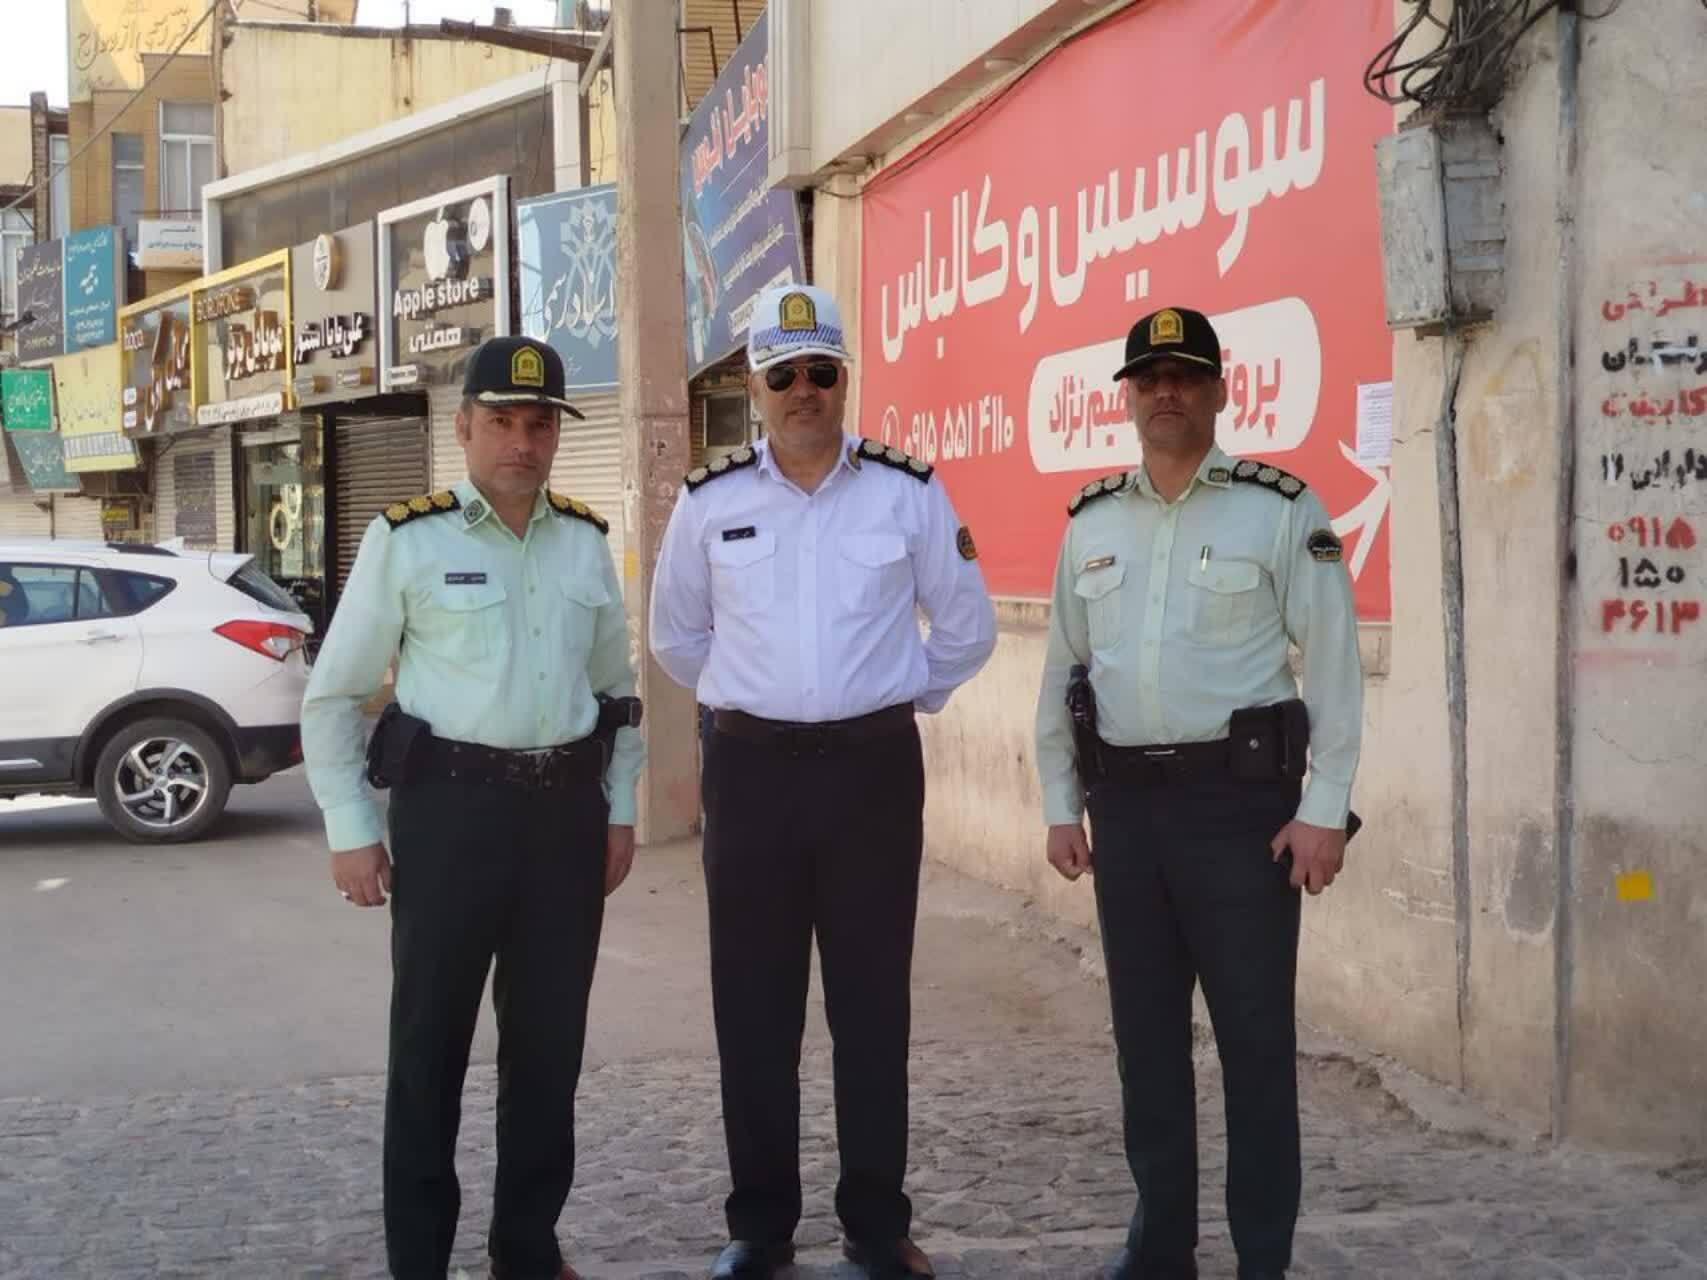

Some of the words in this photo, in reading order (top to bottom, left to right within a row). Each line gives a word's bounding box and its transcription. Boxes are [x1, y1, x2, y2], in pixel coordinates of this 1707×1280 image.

[1049, 78, 1325, 307] سوسیس
[393, 283, 436, 321] Apple
[437, 277, 480, 306] store
[881, 174, 1009, 363] کالباس
[1016, 205, 1040, 335] و
[246, 309, 284, 373] موبایل
[343, 312, 363, 355] علی
[942, 402, 973, 461] ۵۵۱
[978, 394, 1014, 457] ۴۱۱۰
[1607, 516, 1696, 550] ۰۹۱۵
[1619, 557, 1686, 589] ۱۵۰
